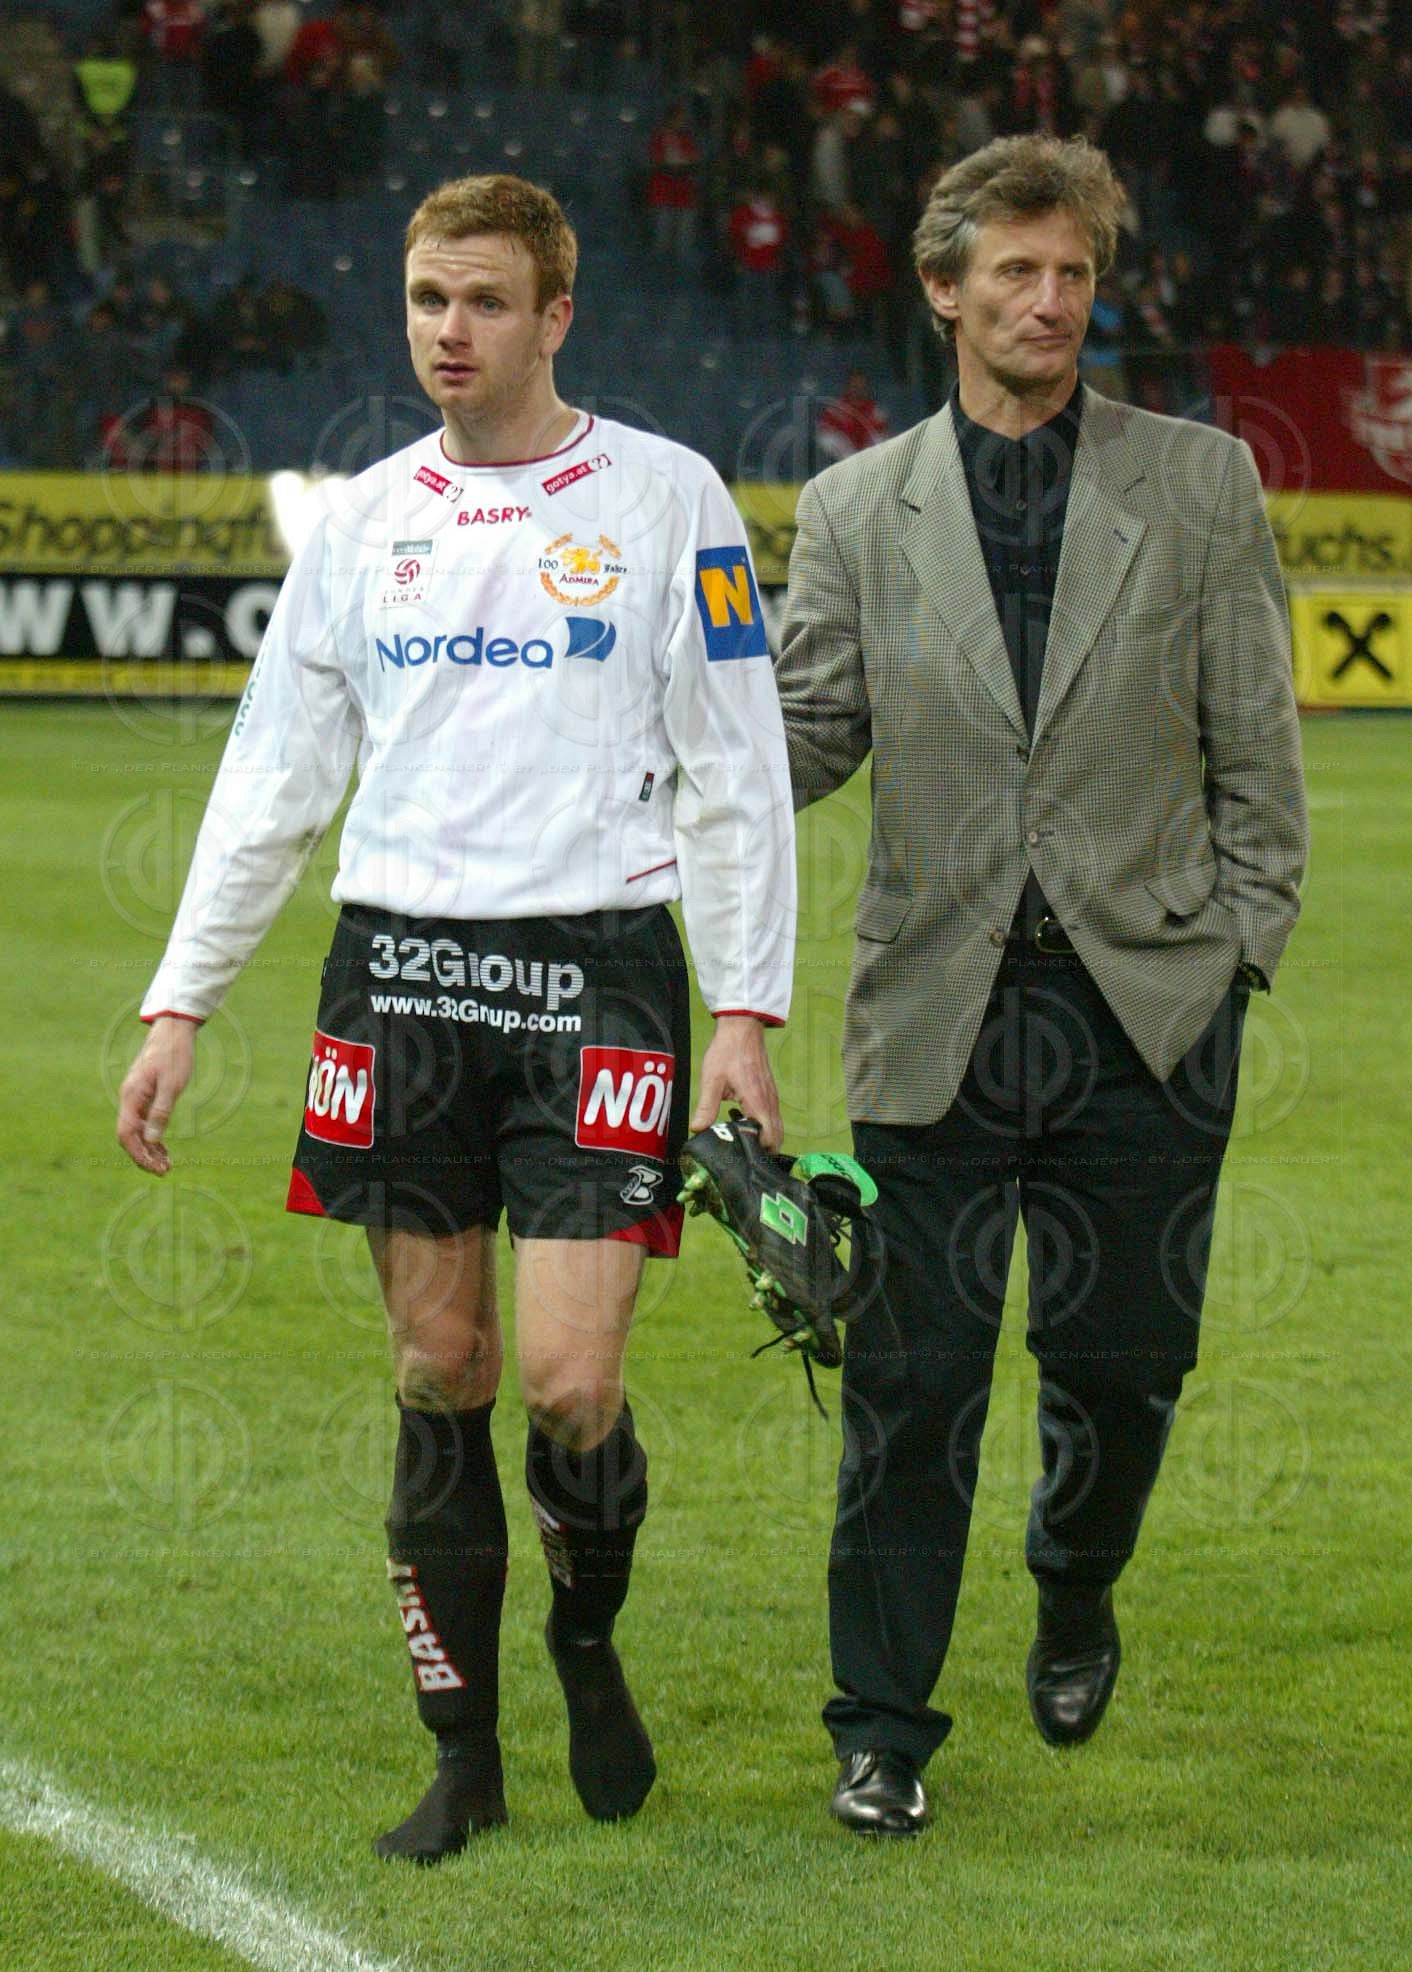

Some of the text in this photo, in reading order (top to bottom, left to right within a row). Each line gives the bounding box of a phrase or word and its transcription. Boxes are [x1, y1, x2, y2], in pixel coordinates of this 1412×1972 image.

[457, 506, 530, 526] BASRY
[538, 557, 559, 570] 100
[700, 565, 753, 629] N
[376, 626, 554, 672] Nordea
